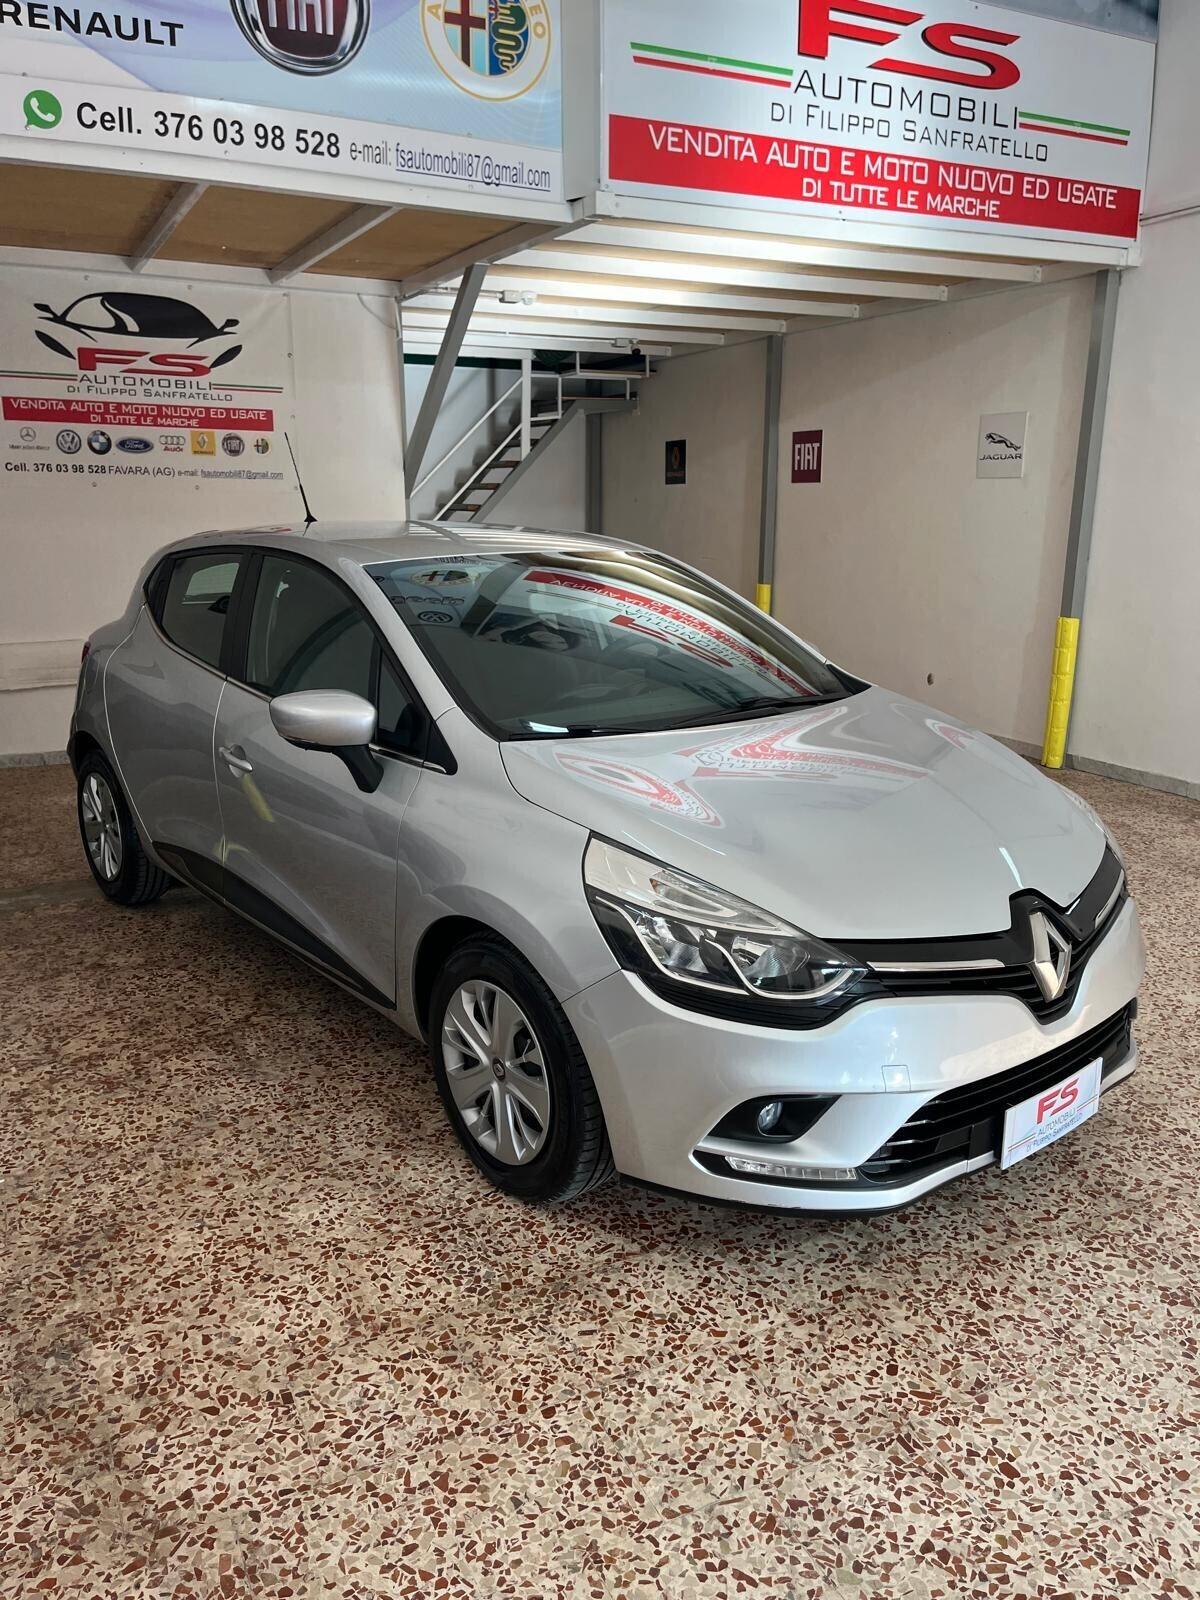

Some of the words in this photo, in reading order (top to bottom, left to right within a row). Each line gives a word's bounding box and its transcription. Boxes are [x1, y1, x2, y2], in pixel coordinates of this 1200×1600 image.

[0, 0, 184, 46] RENAULT
[797, 0, 1021, 90] FS
[794, 69, 1018, 130] AUTOMOBILI
[76, 102, 142, 134] Cell.
[154, 111, 203, 141] 376
[213, 118, 244, 145] 03
[254, 123, 285, 151] 98
[295, 129, 340, 158] 528
[350, 141, 392, 166] e-mail:
[395, 142, 551, 190] fsautomobili87@gmail.com
[771, 102, 793, 124] DI
[806, 104, 890, 138] FILIPPO
[903, 119, 1048, 162] SANFRATELLO
[648, 124, 758, 163] VENDITA
[765, 142, 830, 172] AUTO
[840, 151, 855, 176] E
[864, 154, 929, 185] MOTO
[938, 165, 1014, 195] NUOVO
[1022, 177, 1050, 200] ED
[1057, 182, 1118, 209] USATE
[802, 177, 822, 199] DI
[829, 181, 889, 207] TUTTE
[896, 189, 919, 210] LE
[926, 194, 1000, 219] MARCHE
[77, 347, 211, 378] FS
[67, 385, 80, 393] DI
[87, 385, 137, 397] FILIPPO
[144, 389, 233, 401] SANFRATELLO
[79, 374, 212, 390] AUTOMOBILI
[10, 398, 66, 411] VENDITA
[70, 401, 104, 413] AUTO
[109, 403, 118, 413] E
[122, 404, 157, 415] MOTO
[162, 406, 206, 418] NUOVO
[210, 408, 226, 418] ED
[230, 410, 267, 420] USATE
[90, 414, 101, 423] DI
[105, 415, 137, 424] TUTTE
[141, 417, 154, 425] LE
[157, 417, 199, 427] MARCHE
[5, 462, 30, 472] Cell.
[33, 463, 52, 473] 376
[55, 464, 69, 473] 03
[72, 464, 84, 474] 98
[88, 465, 107, 474] 528
[108, 465, 150, 476] FAVARA
[152, 467, 175, 478] (AG)
[794, 443, 820, 470] FIAT
[979, 453, 1022, 461] JAGUAR
[1036, 1077, 1079, 1125] FS
[1037, 1107, 1076, 1136] AUTOMOBILI
